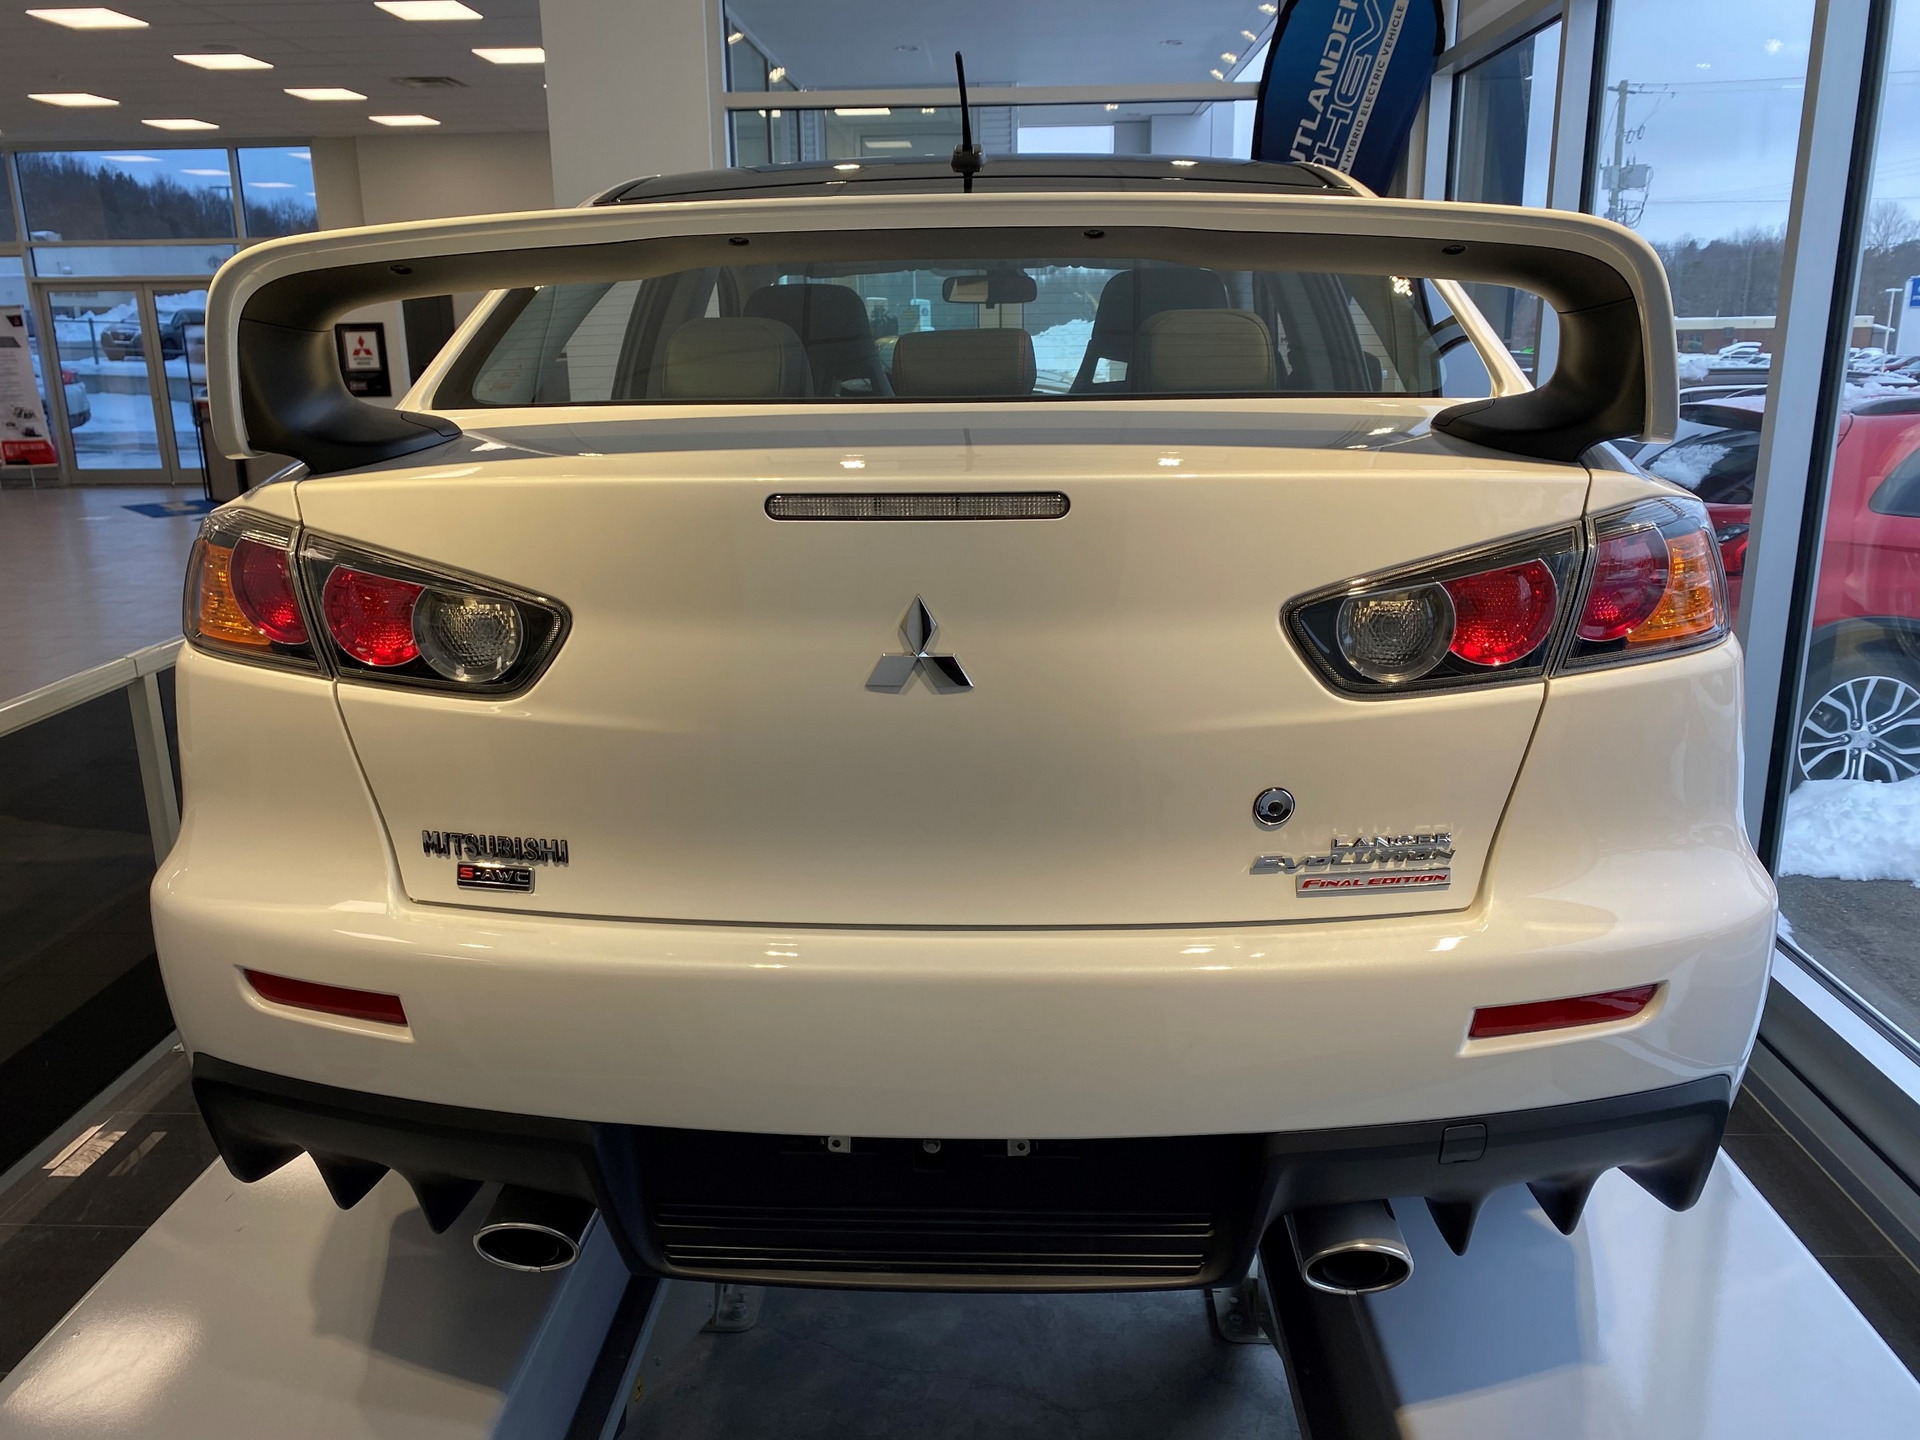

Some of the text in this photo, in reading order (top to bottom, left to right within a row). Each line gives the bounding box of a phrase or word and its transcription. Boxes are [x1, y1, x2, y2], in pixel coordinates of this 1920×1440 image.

[1344, 5, 1405, 163] HYBRID ELECTRIC VEHICLE
[422, 830, 569, 865] MITSUBISHI
[1332, 832, 1452, 850] LANCER
[460, 867, 529, 883] S-AWC
[1302, 874, 1448, 889] FINAL EDITION
